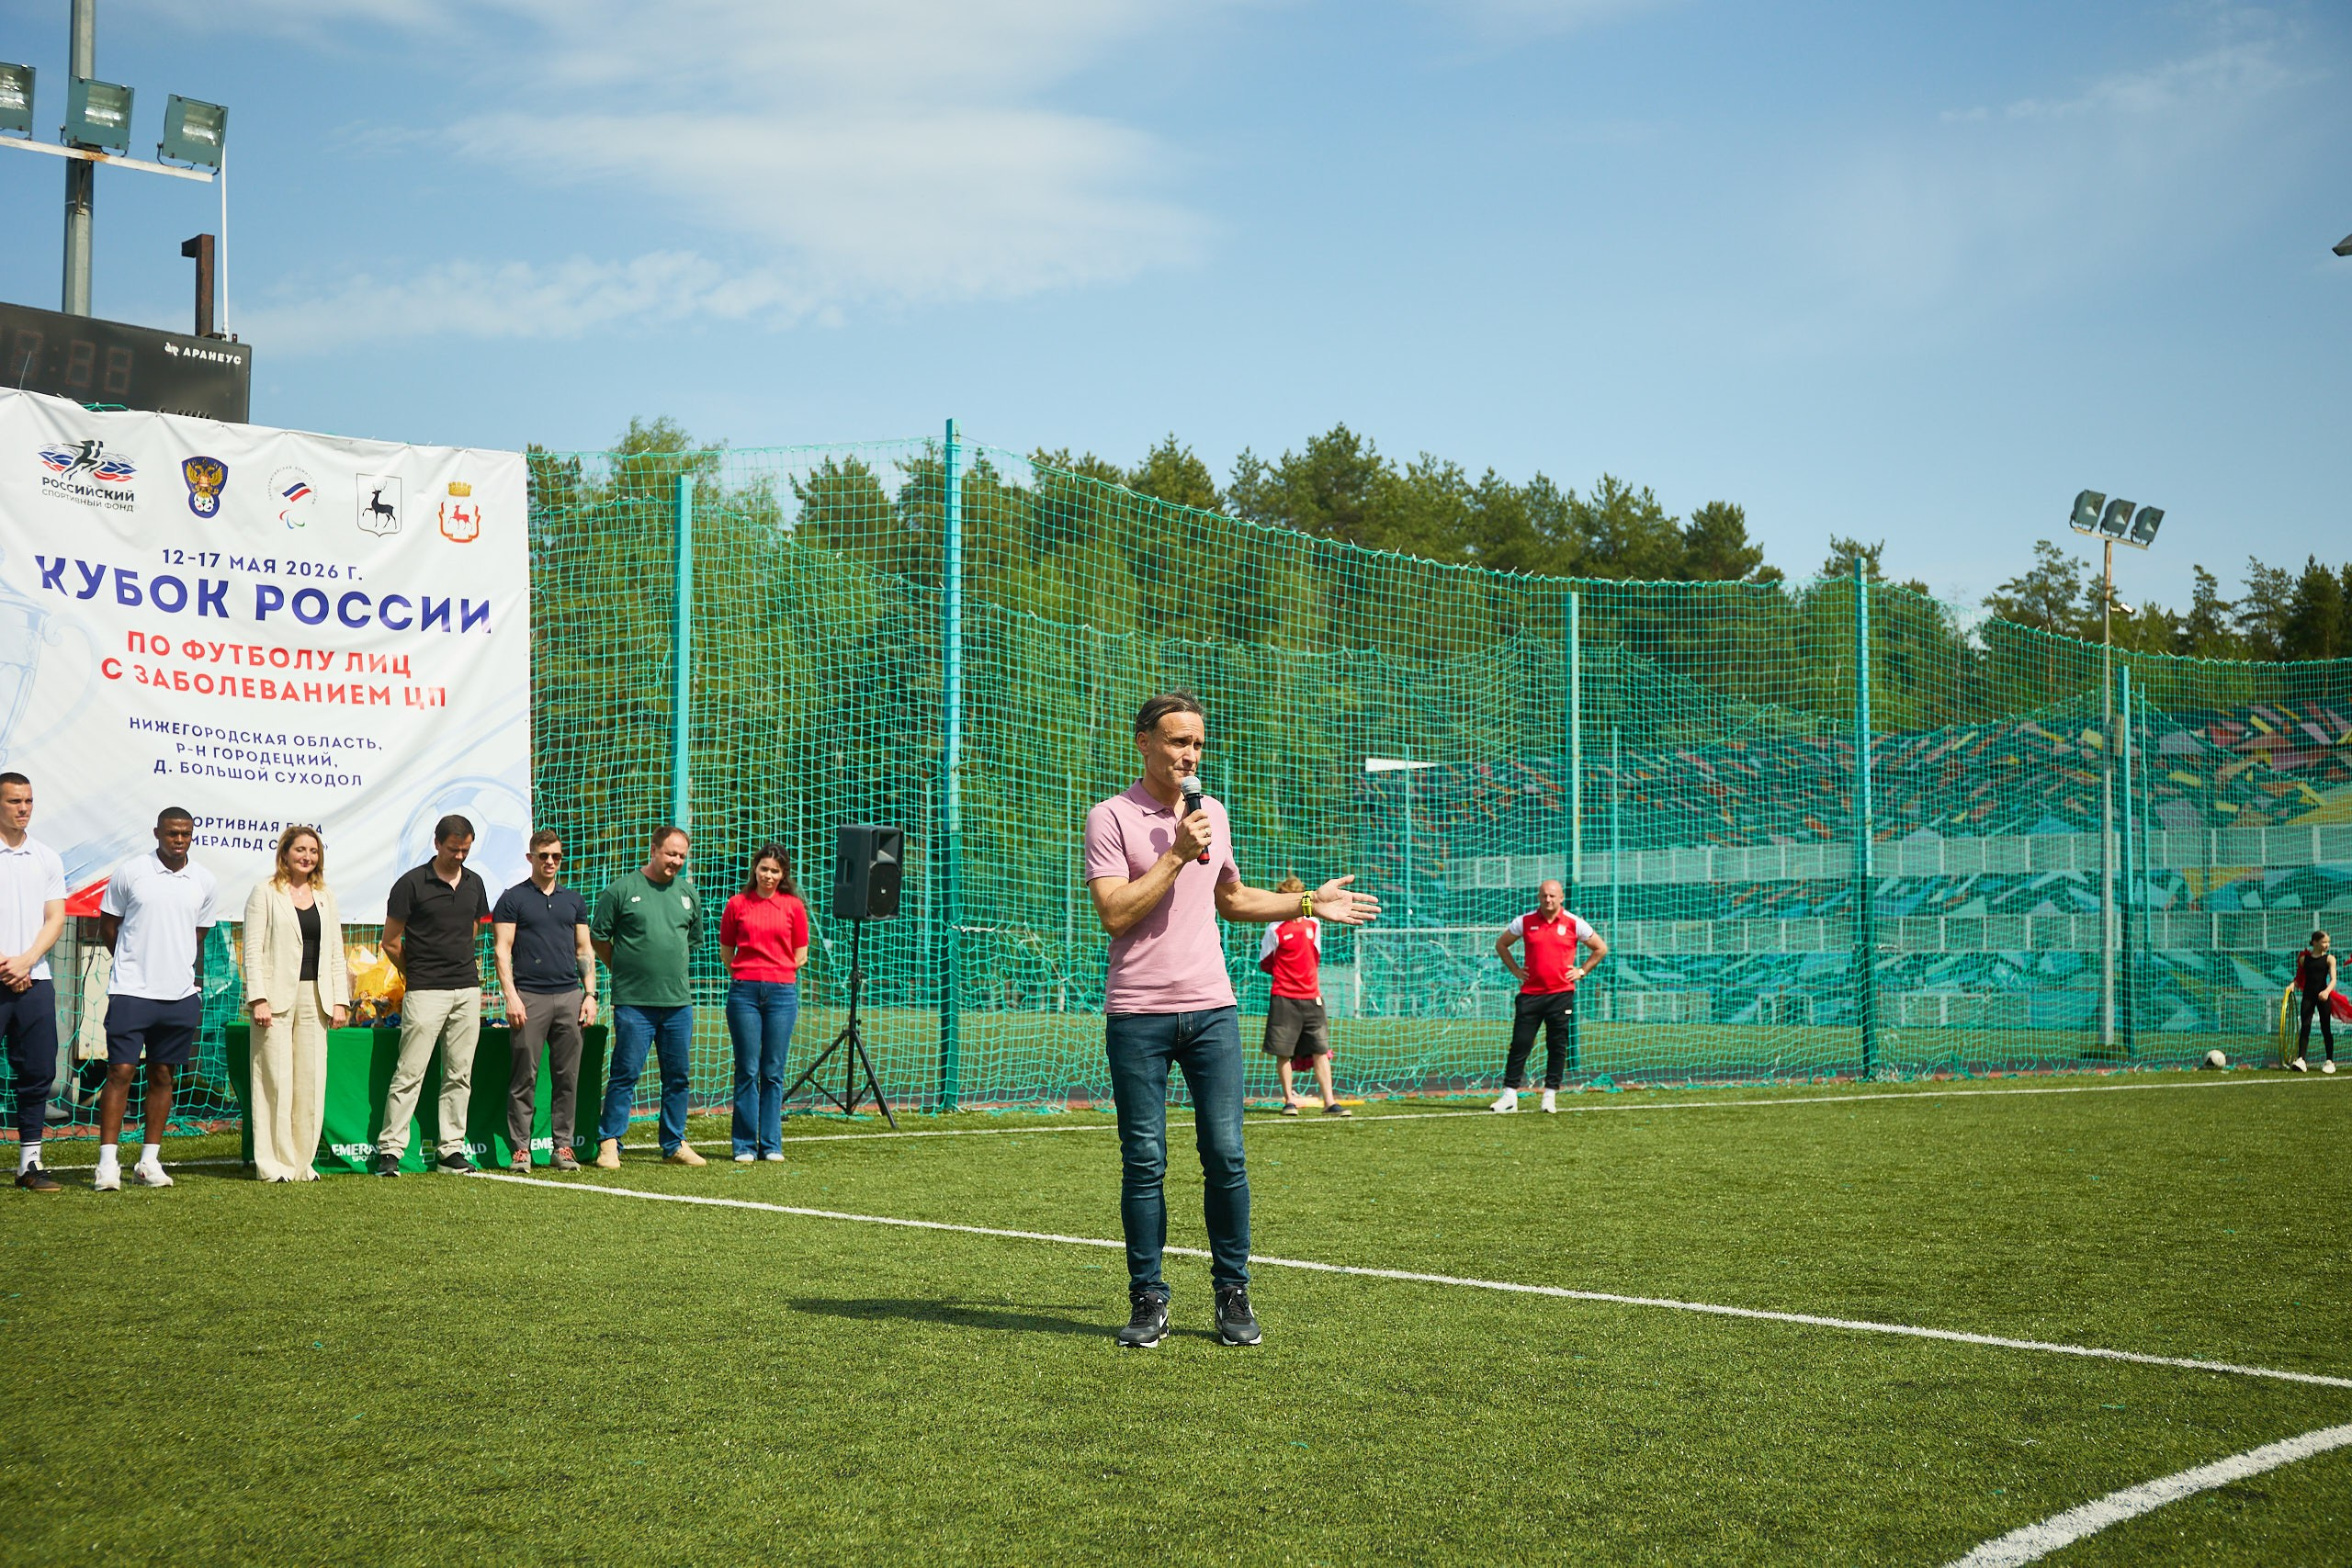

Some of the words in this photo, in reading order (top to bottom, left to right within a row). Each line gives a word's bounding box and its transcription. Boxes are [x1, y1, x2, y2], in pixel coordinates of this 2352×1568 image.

[183, 346, 242, 365] АРАНЕУС
[42, 476, 135, 502] РОССИЙСКИЙ
[42, 489, 102, 507] СПОРТИВНЫЙ
[105, 502, 134, 513] ФОНД
[163, 549, 220, 568] 12-17
[230, 556, 277, 573] МАЯ
[286, 561, 339, 578] 2026
[348, 566, 364, 580] Г.
[35, 555, 230, 619] КУБОК
[255, 584, 492, 634] РОССИИ
[129, 630, 171, 656] ПО
[182, 639, 335, 671] ФУТБОЛУ
[345, 652, 412, 678] ЛИЦ
[101, 658, 123, 681] С
[134, 664, 390, 705] ЗАБОЛЕВАНИЕМ
[405, 686, 447, 709] ЦП
[130, 716, 287, 745] НИЖЕГОРОДСКАЯ
[293, 735, 382, 750] ОБЛАСТЬ,
[175, 742, 206, 757] Р-Н
[213, 747, 339, 768] ГОРОДЕЦКИЙ,
[153, 759, 173, 774] Д.
[180, 761, 268, 782] БОЛЬШОЙ
[275, 771, 362, 787] СУХОДОЛ
[193, 817, 279, 832] ОРТИВНАЯ
[191, 835, 263, 852] МЕРАЛЬД
[331, 1143, 379, 1156] EMERA
